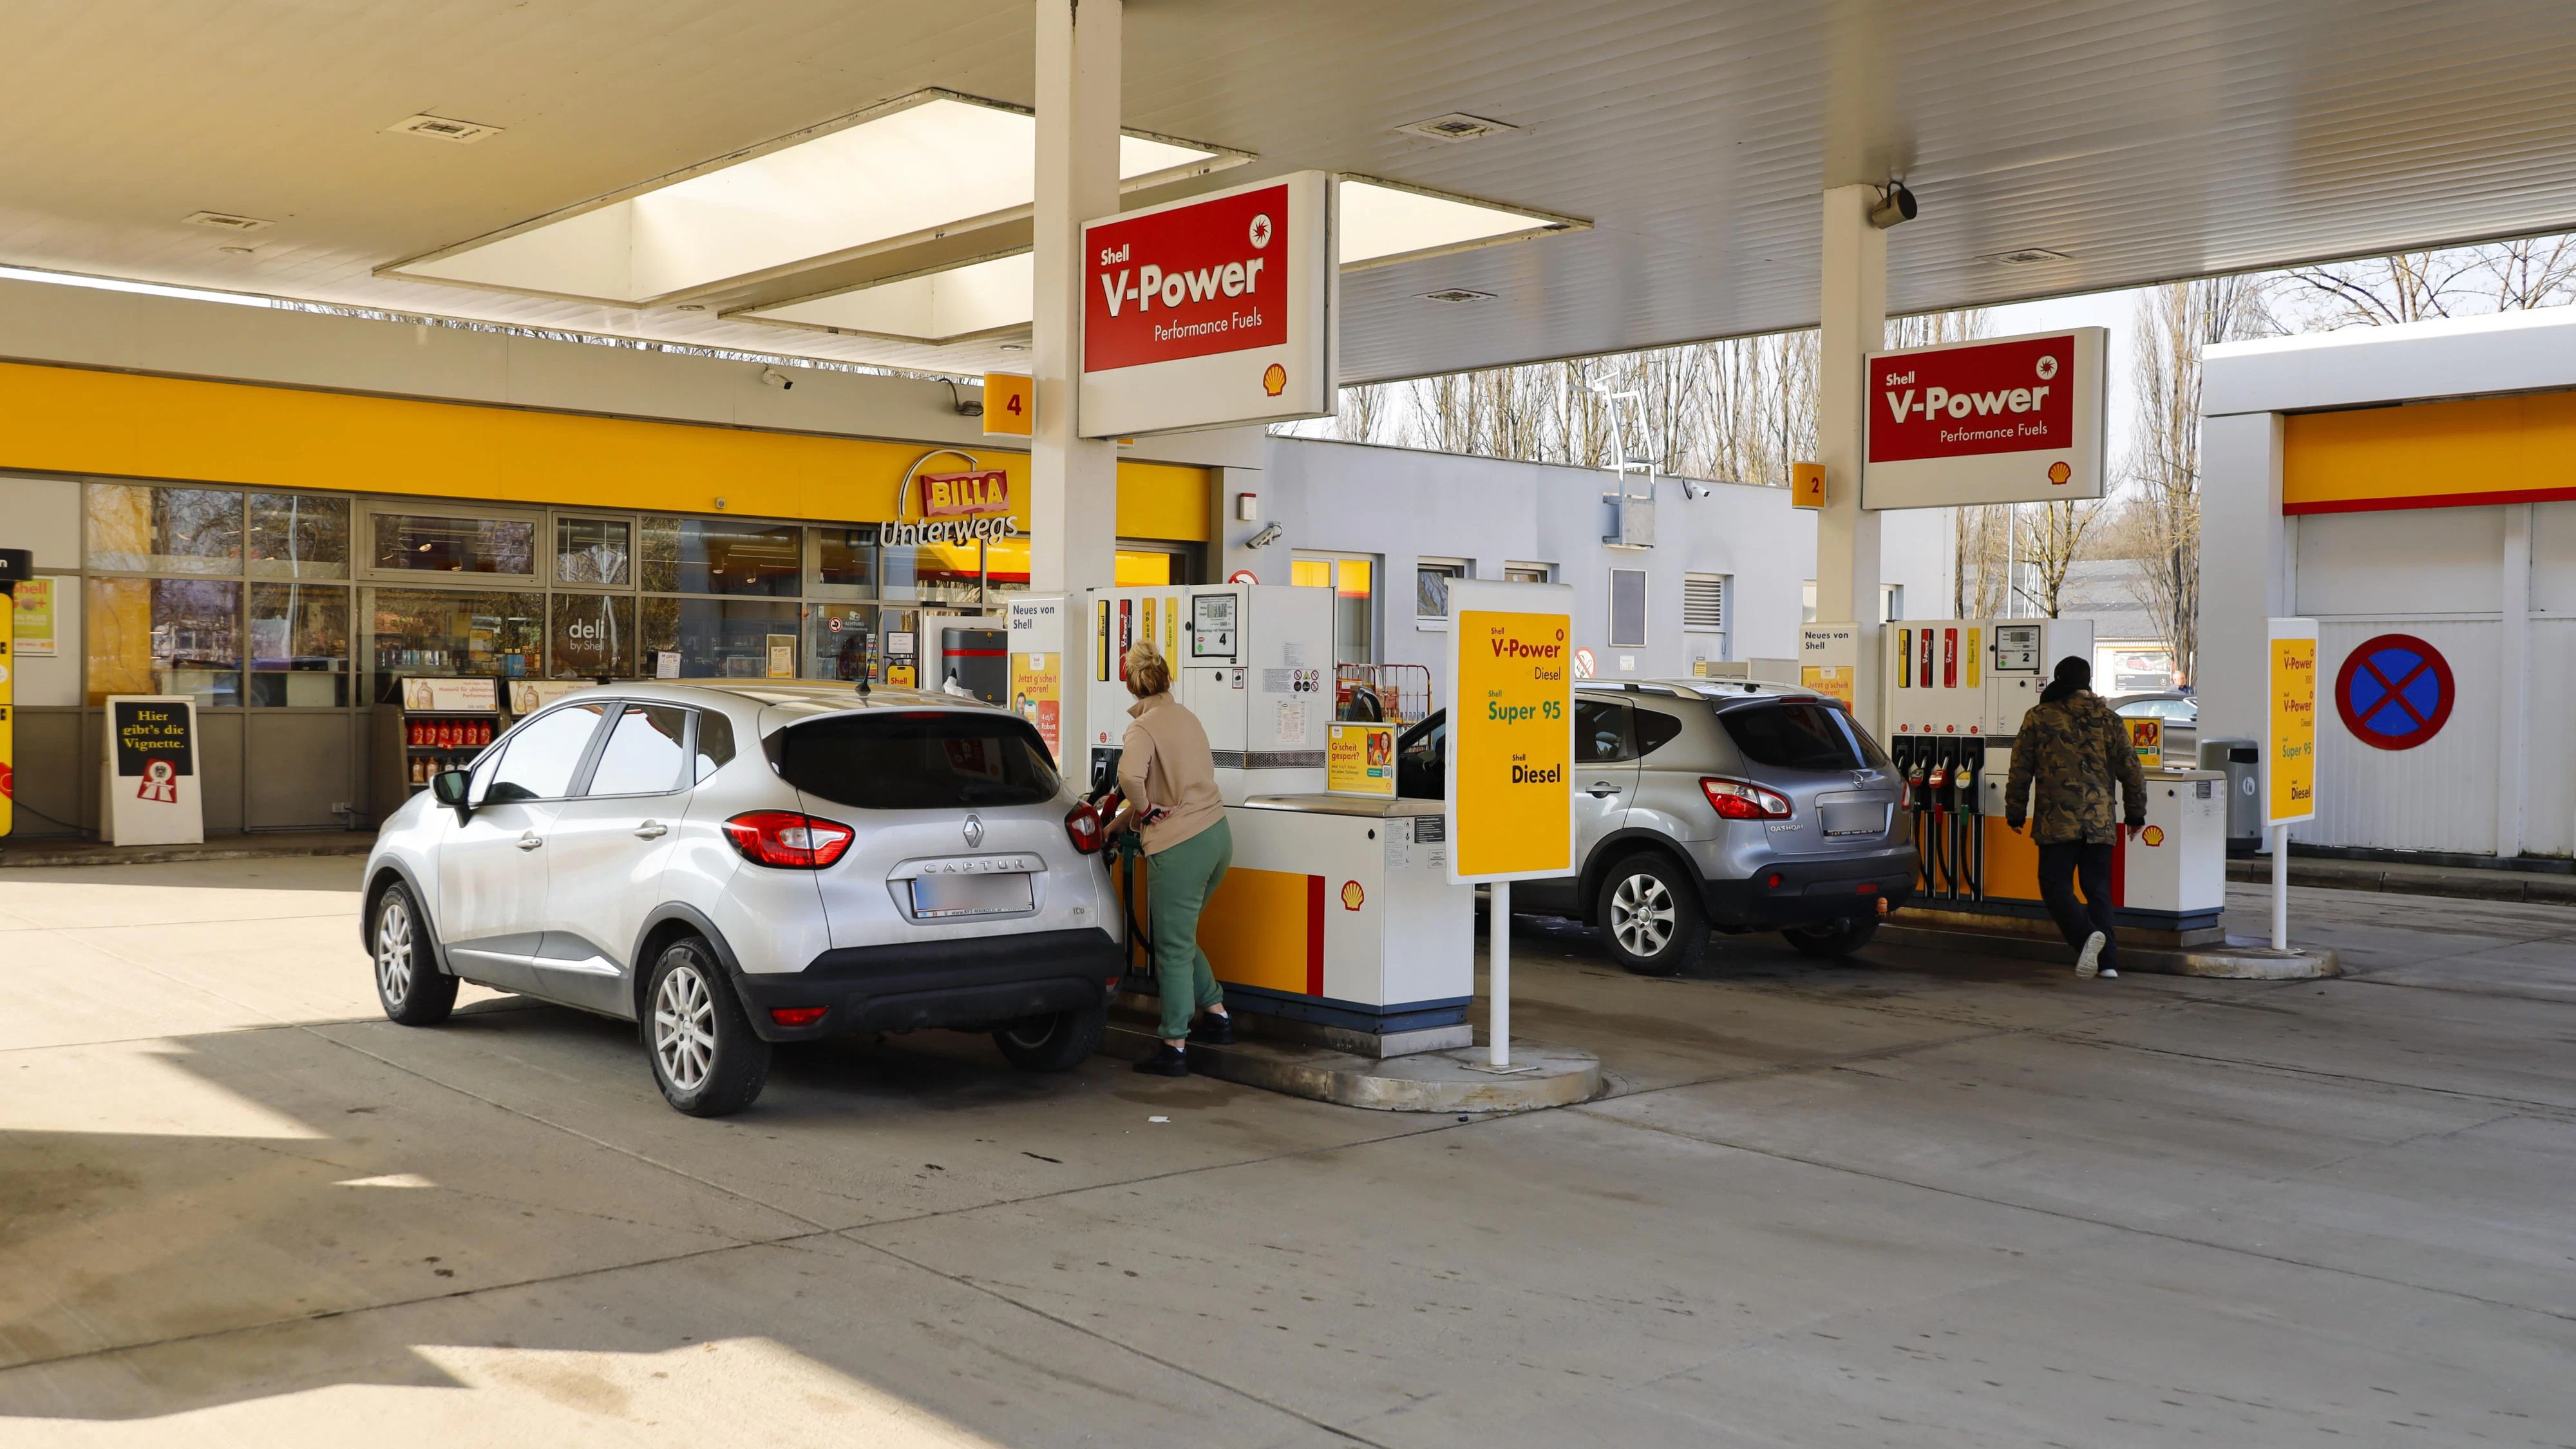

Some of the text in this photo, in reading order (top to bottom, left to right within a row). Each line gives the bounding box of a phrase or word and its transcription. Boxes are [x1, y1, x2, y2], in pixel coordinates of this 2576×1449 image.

[1101, 243, 1130, 266] Shell
[1101, 257, 1264, 318] V-Power
[1155, 306, 1262, 342] Performance Fuels
[1886, 370, 1915, 386] Shell
[1007, 393, 1022, 416] 4
[1885, 385, 2050, 424] V-Power
[1940, 420, 2048, 443] Performance Fuels
[932, 478, 1003, 507] BILLA
[1812, 477, 1819, 493] 2
[880, 516, 1018, 547] Unterwegs
[1013, 605, 1055, 615] Neues von
[569, 618, 605, 639] deli
[1013, 619, 1032, 630] Shell
[570, 639, 604, 653] by Shell
[1219, 632, 1227, 645] 4
[1491, 639, 1560, 658] V-Power
[2023, 653, 2030, 662] 2
[2284, 657, 2312, 670] V-Power
[1018, 674, 1032, 683] Jetzt
[1535, 667, 1560, 680] Diesel
[1026, 685, 1048, 695] sparen!
[1488, 701, 1560, 724] Super 95
[2284, 699, 2311, 712] V-Power
[137, 710, 169, 721] Hier
[123, 725, 184, 735] gibt's die
[124, 738, 184, 752] Vignette.
[1332, 742, 1357, 752] G'scheit
[2282, 742, 2311, 760] Super 95
[1331, 752, 1359, 761] gespart?
[1512, 764, 1560, 784] Diesel
[2291, 784, 2311, 800] Diesel
[924, 858, 1025, 873] CAPTUR
